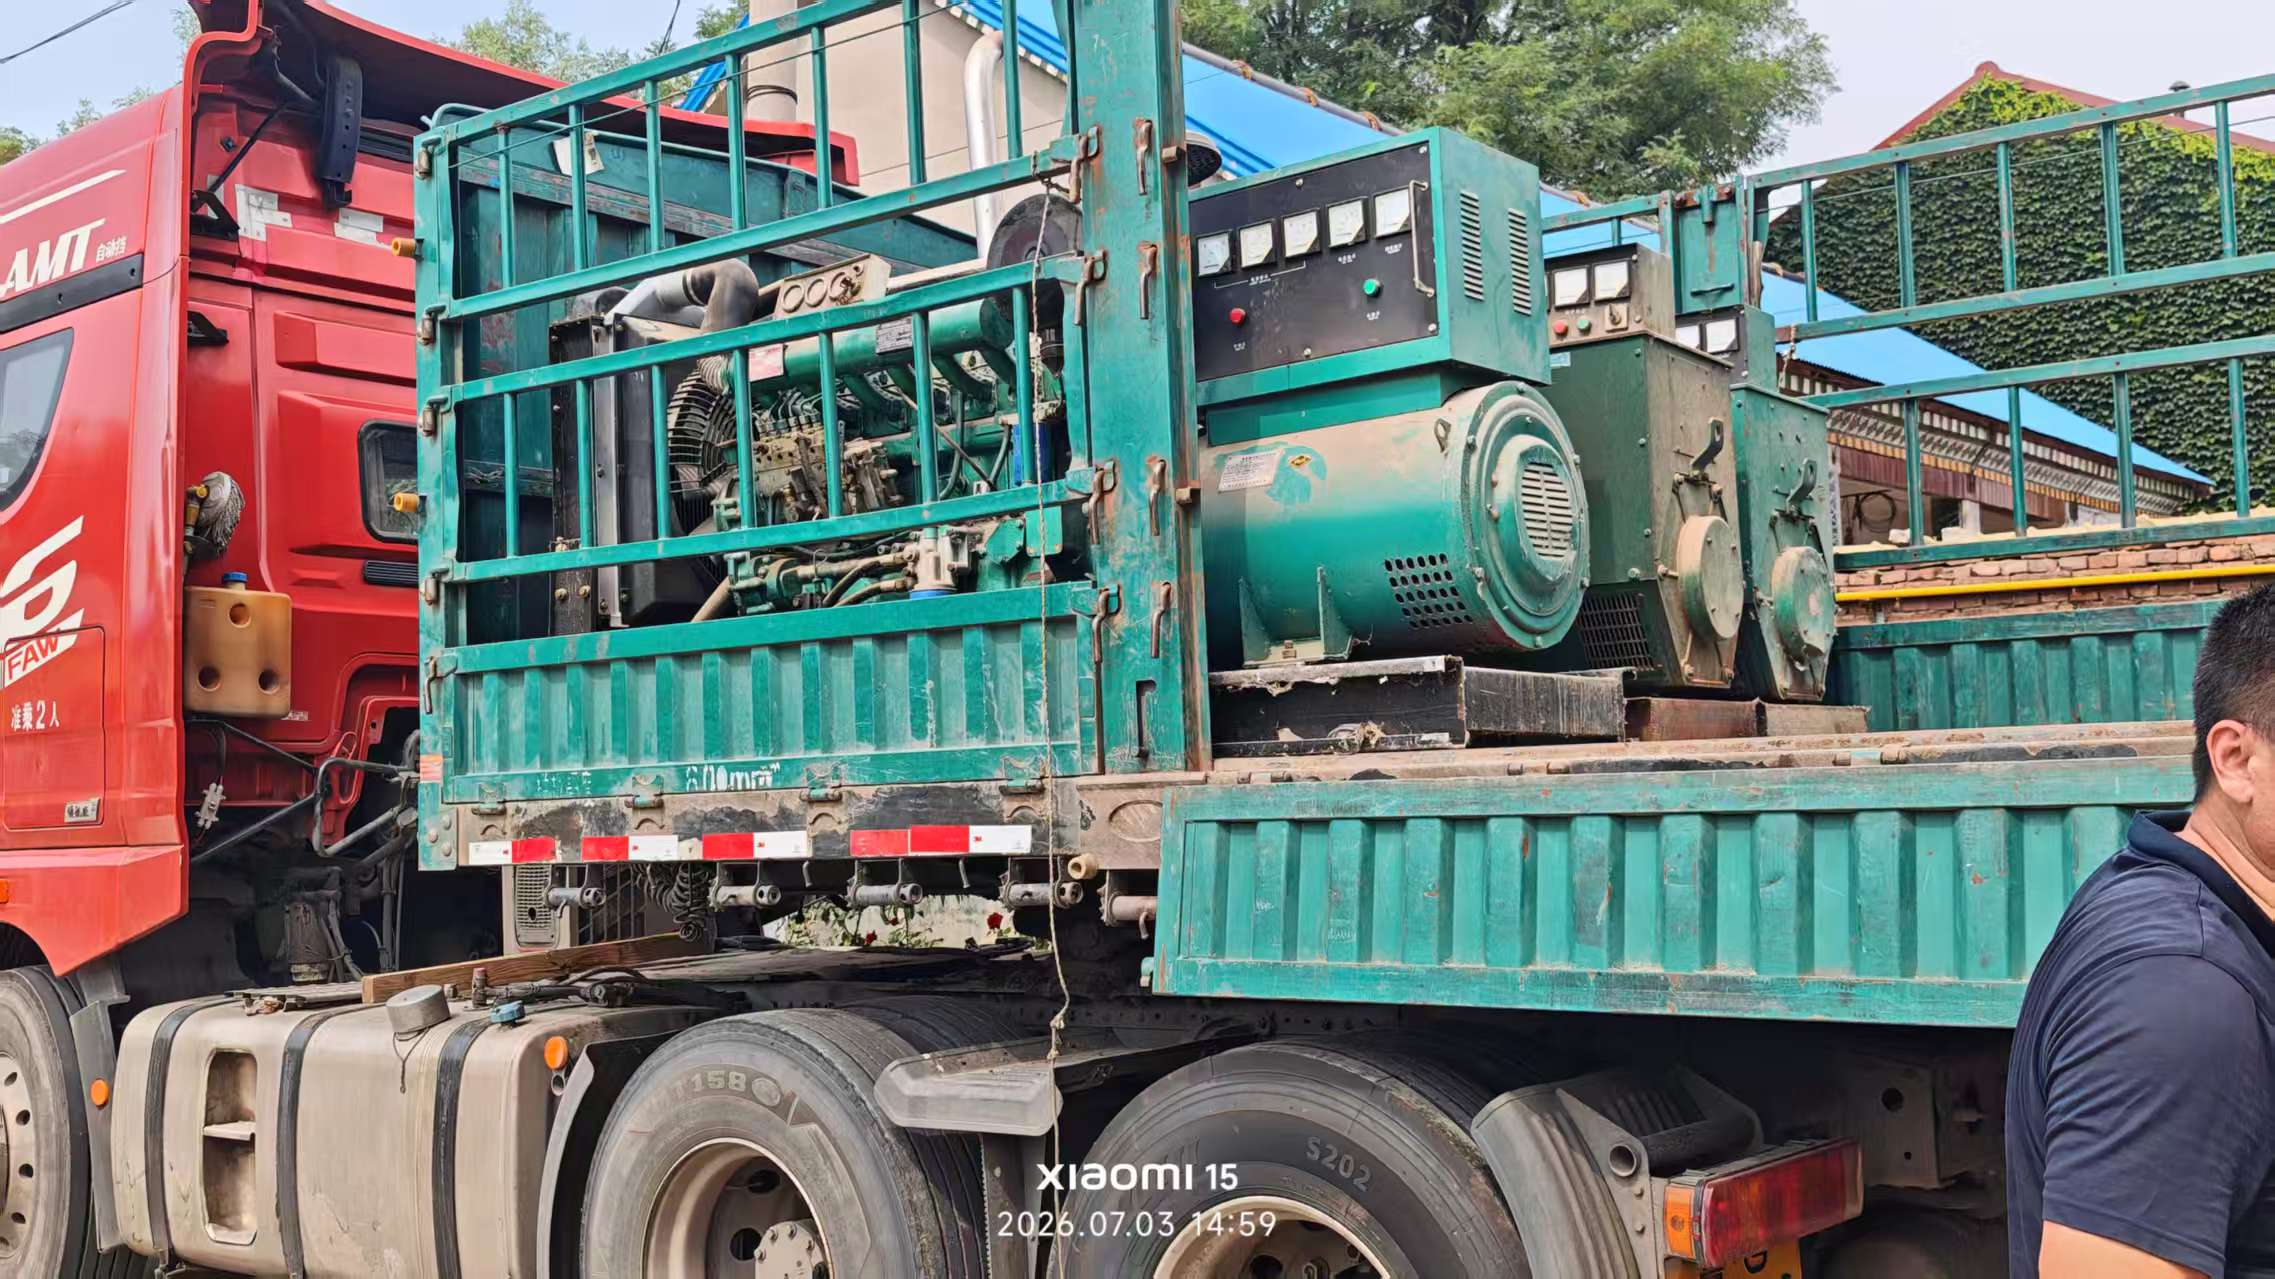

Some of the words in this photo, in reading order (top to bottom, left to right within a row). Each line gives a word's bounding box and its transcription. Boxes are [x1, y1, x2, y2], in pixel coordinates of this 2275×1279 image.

[0, 217, 106, 298] AMT
[7, 635, 59, 680] FAW
[1305, 1135, 1371, 1193] S202
